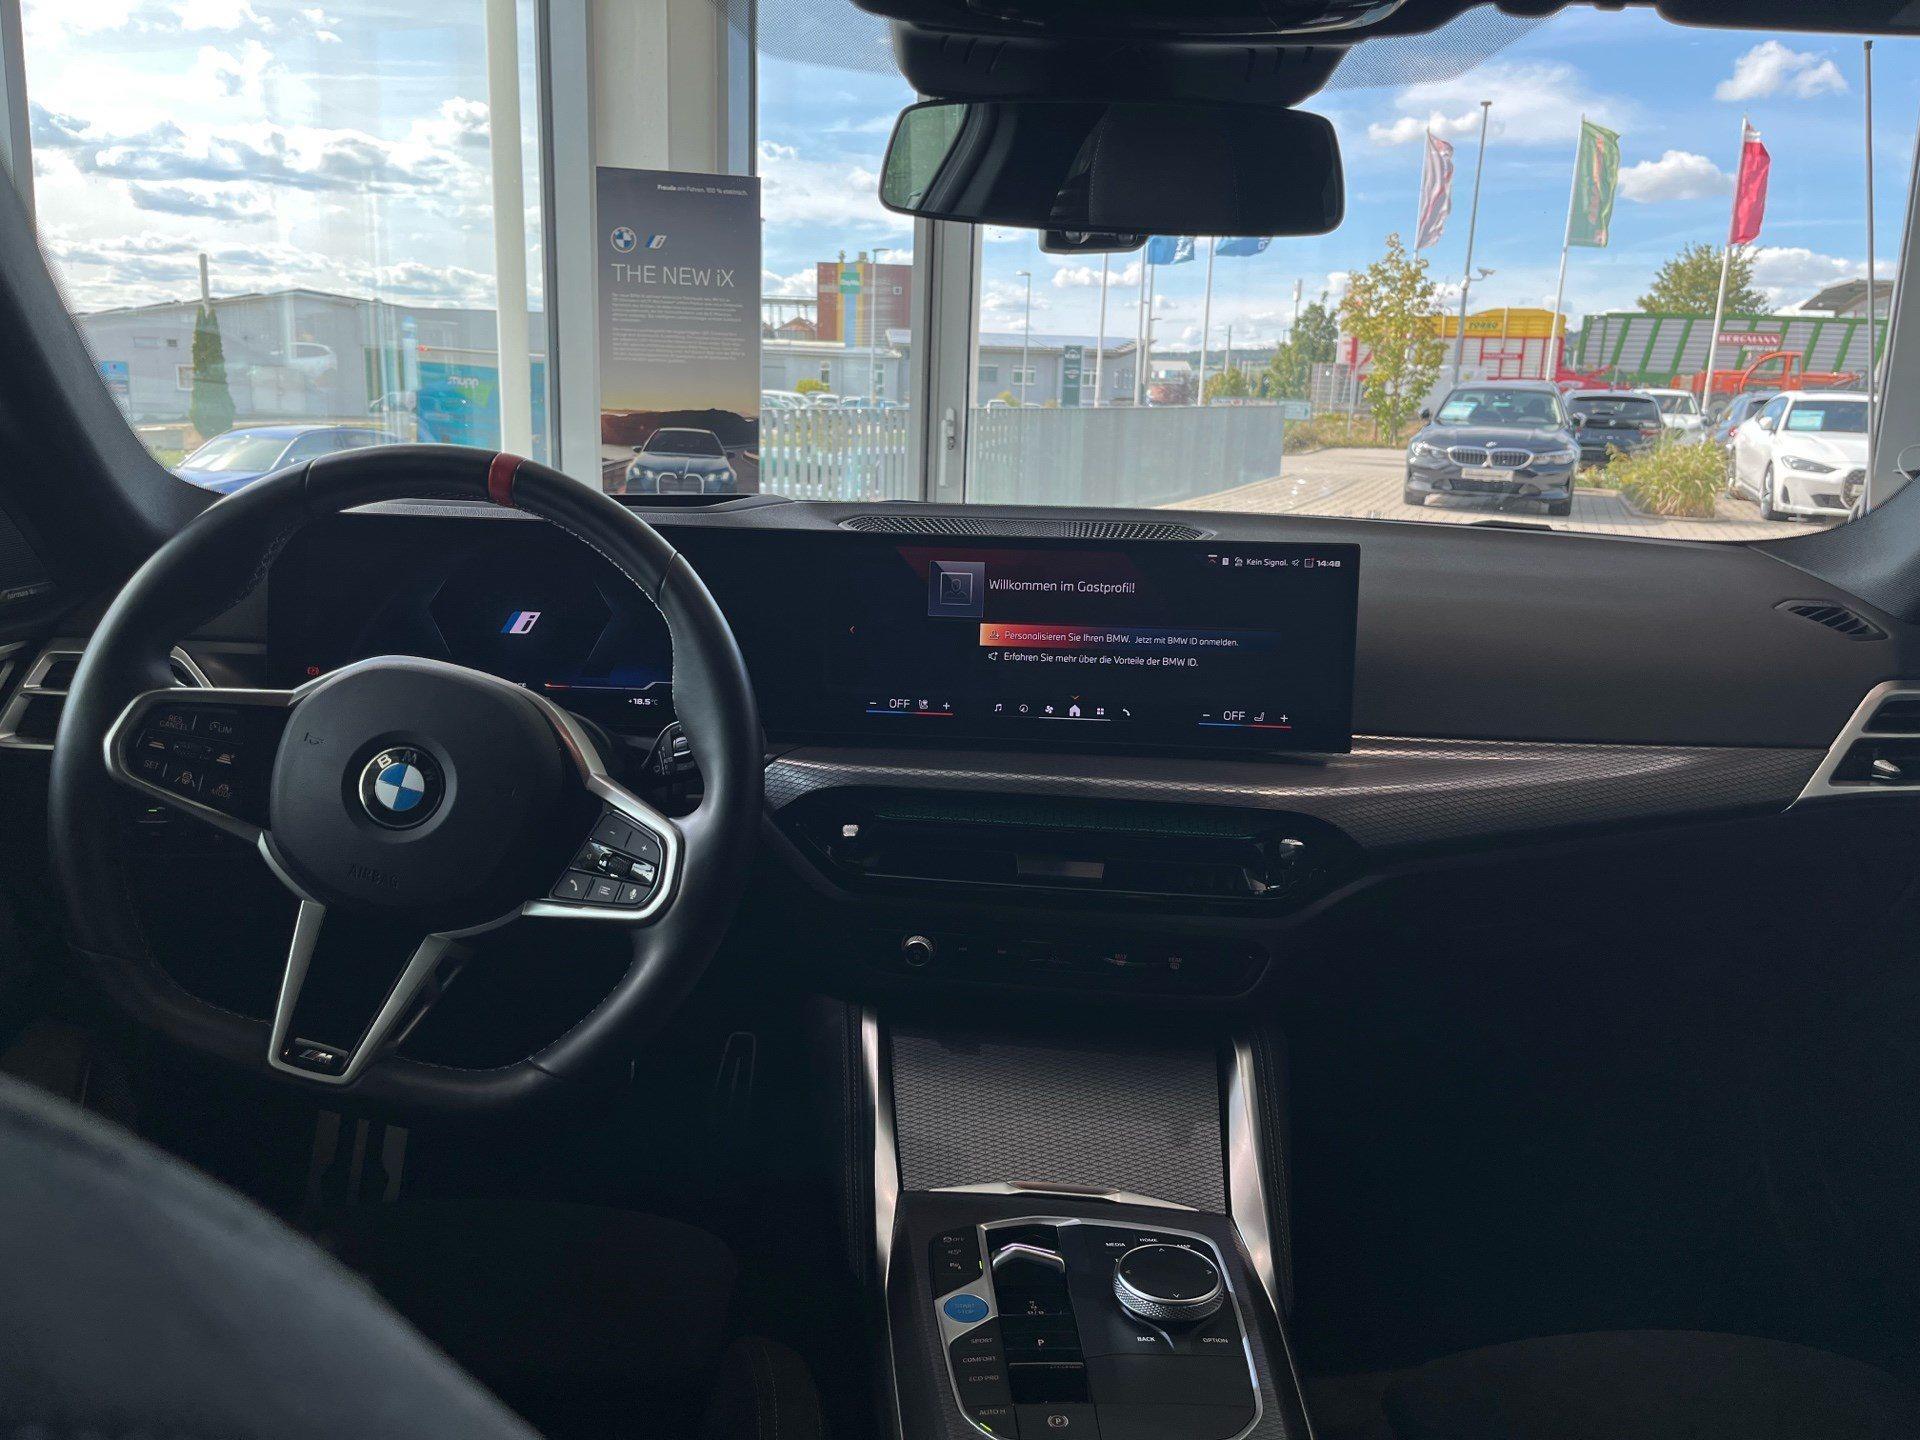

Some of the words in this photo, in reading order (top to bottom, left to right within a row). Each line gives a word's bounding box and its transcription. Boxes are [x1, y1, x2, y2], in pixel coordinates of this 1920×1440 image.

[611, 264, 657, 284] THE
[663, 266, 711, 287] NEW
[717, 269, 735, 288] iX
[1246, 558, 1263, 566] Kein
[1264, 558, 1288, 568] Signal.
[989, 579, 1057, 591] Willkommen
[1060, 581, 1074, 591] im
[1077, 581, 1135, 595] Gastprofil!
[1004, 630, 1066, 642] Personalisieren
[1068, 632, 1081, 643] Sie
[1083, 632, 1104, 643] Ihren
[1106, 634, 1131, 644] BMW.
[1134, 636, 1152, 644] Jetzt
[1153, 637, 1166, 645] mit
[1167, 636, 1187, 646] BMW
[1189, 637, 1198, 646] ID
[1199, 638, 1239, 647] anmelden.
[1004, 651, 1038, 662] Erfahren
[1040, 653, 1053, 663] Sie
[1055, 654, 1076, 663] mehr
[1078, 655, 1097, 664] über
[1099, 656, 1112, 665] die
[1113, 656, 1145, 666] Vorteile
[1146, 656, 1160, 666] der
[1162, 657, 1185, 667] BMW
[1187, 658, 1199, 667] ID.
[889, 698, 911, 709] OFF
[1223, 710, 1246, 721] OFF
